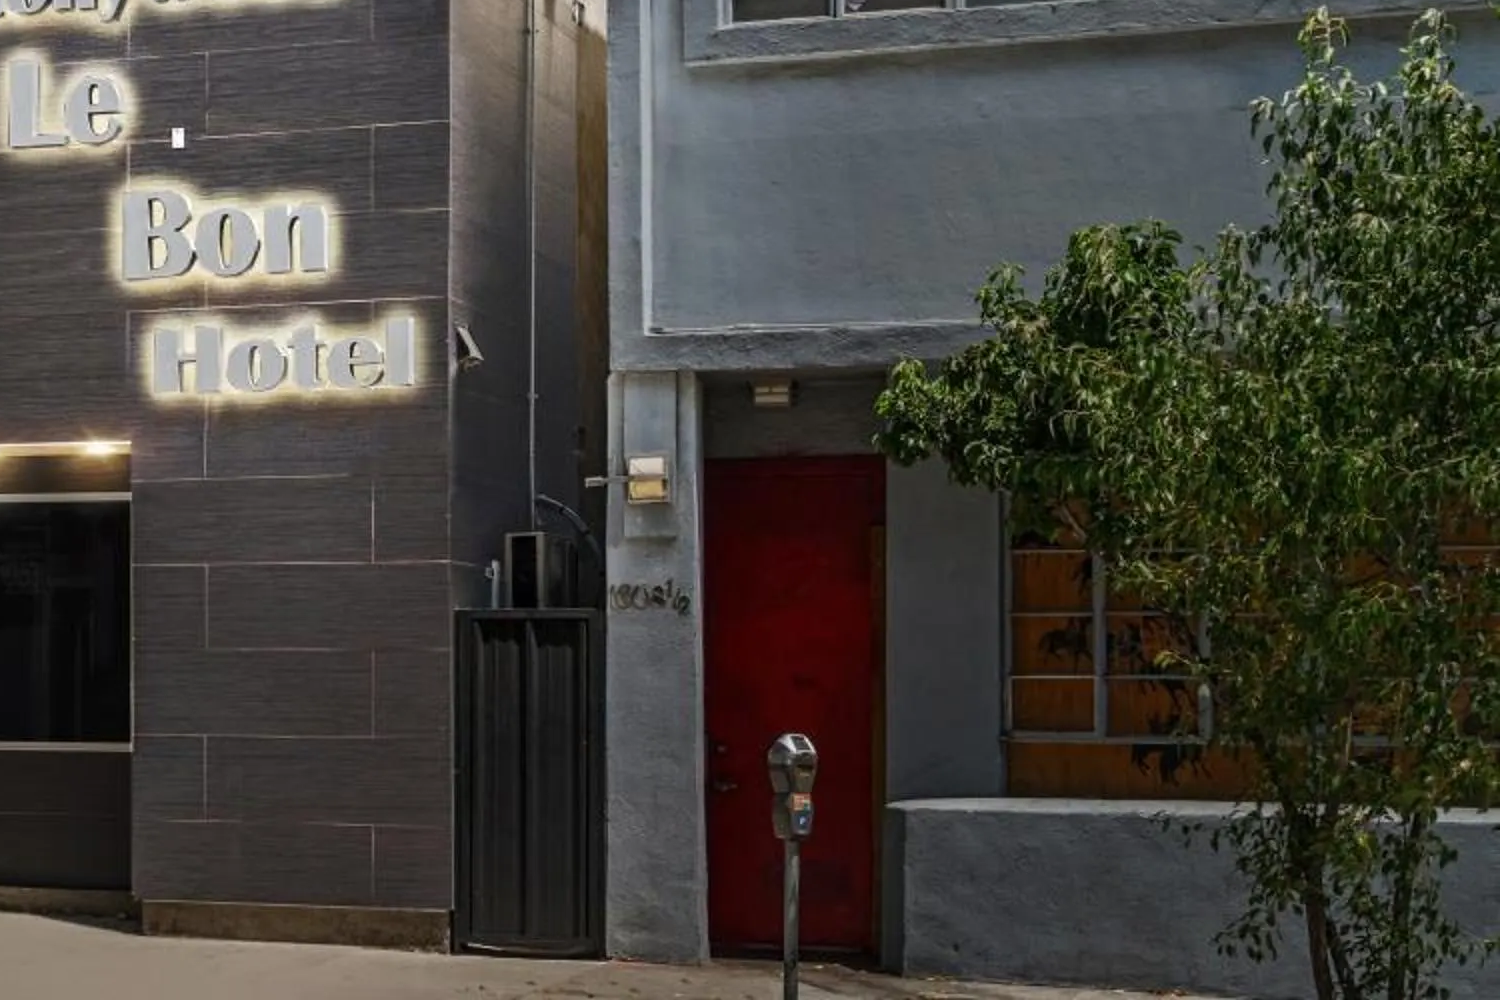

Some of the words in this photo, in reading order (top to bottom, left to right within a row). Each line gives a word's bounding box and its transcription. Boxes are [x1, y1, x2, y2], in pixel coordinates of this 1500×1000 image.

[8, 59, 123, 149] Le
[121, 188, 330, 281] Bon
[152, 316, 415, 393] Hotel
